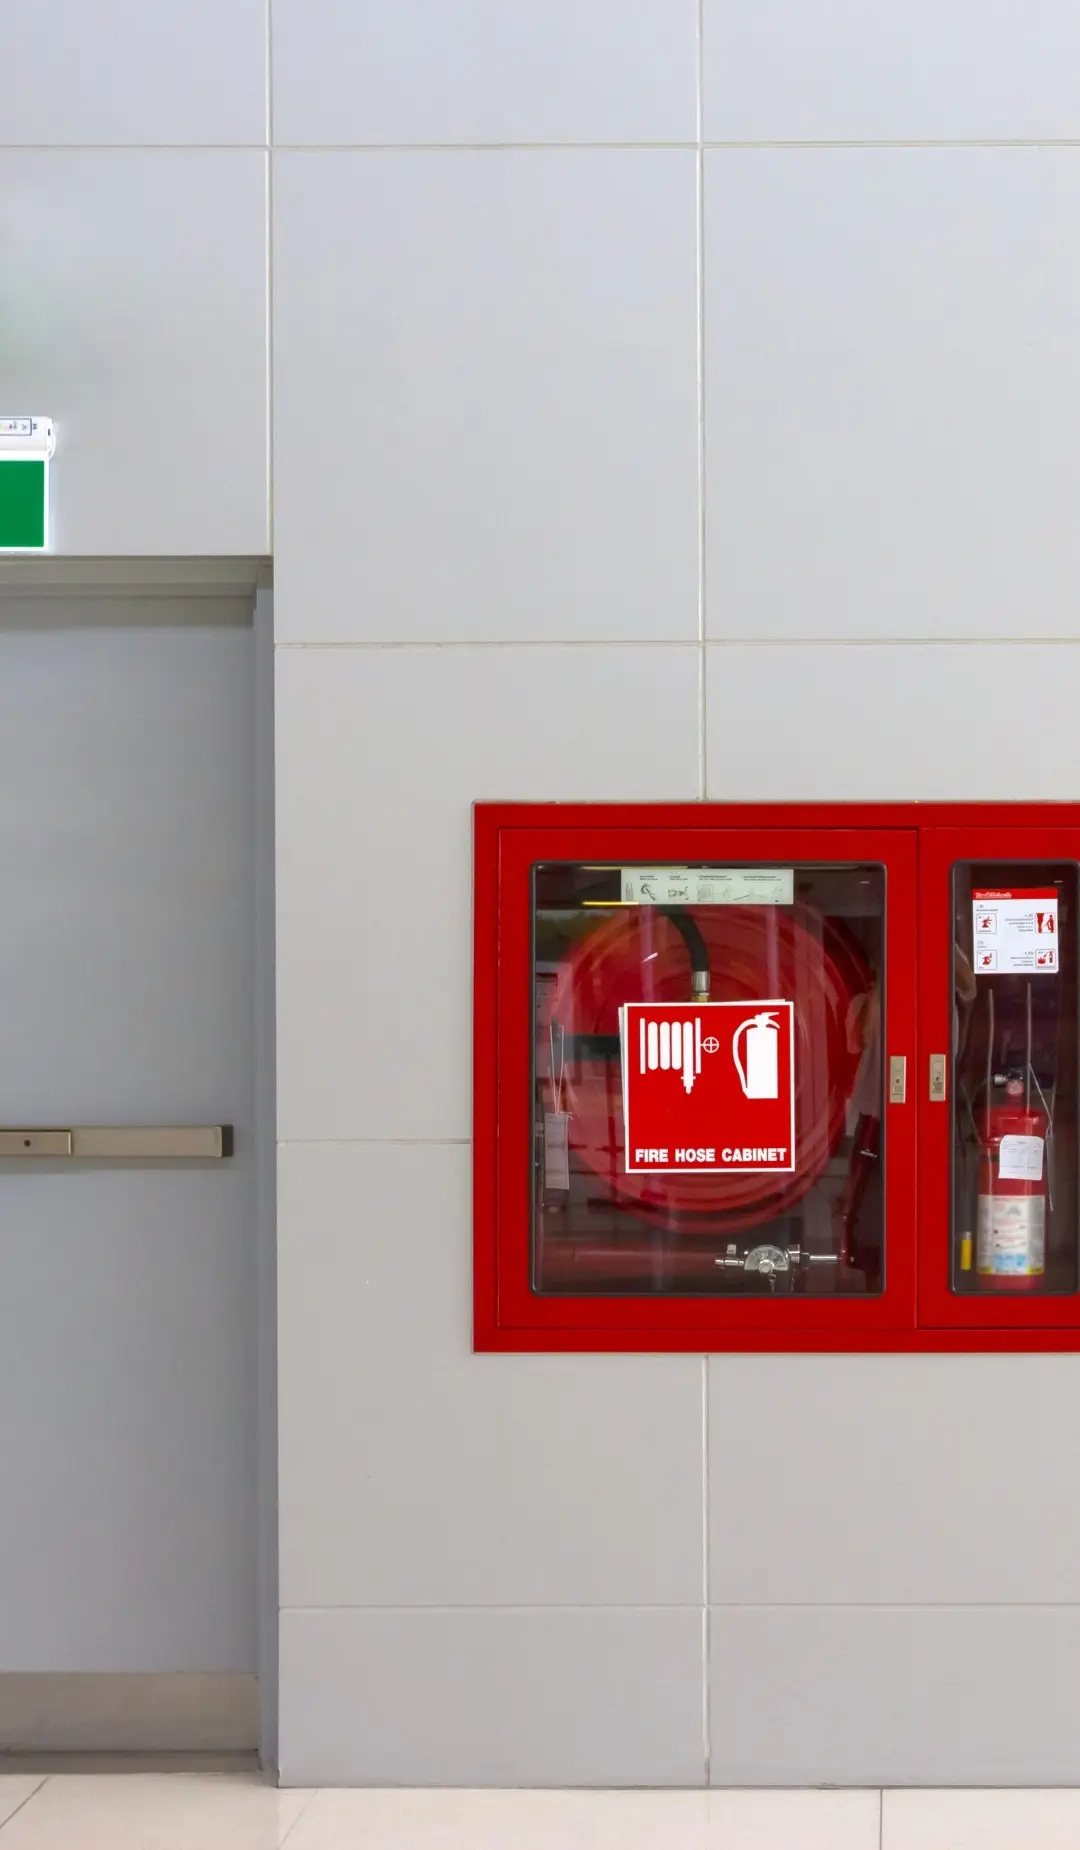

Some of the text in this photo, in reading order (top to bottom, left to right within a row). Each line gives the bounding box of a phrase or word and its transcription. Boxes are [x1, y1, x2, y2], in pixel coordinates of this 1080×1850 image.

[635, 1147, 787, 1163] FIRE HOSE CABINET
